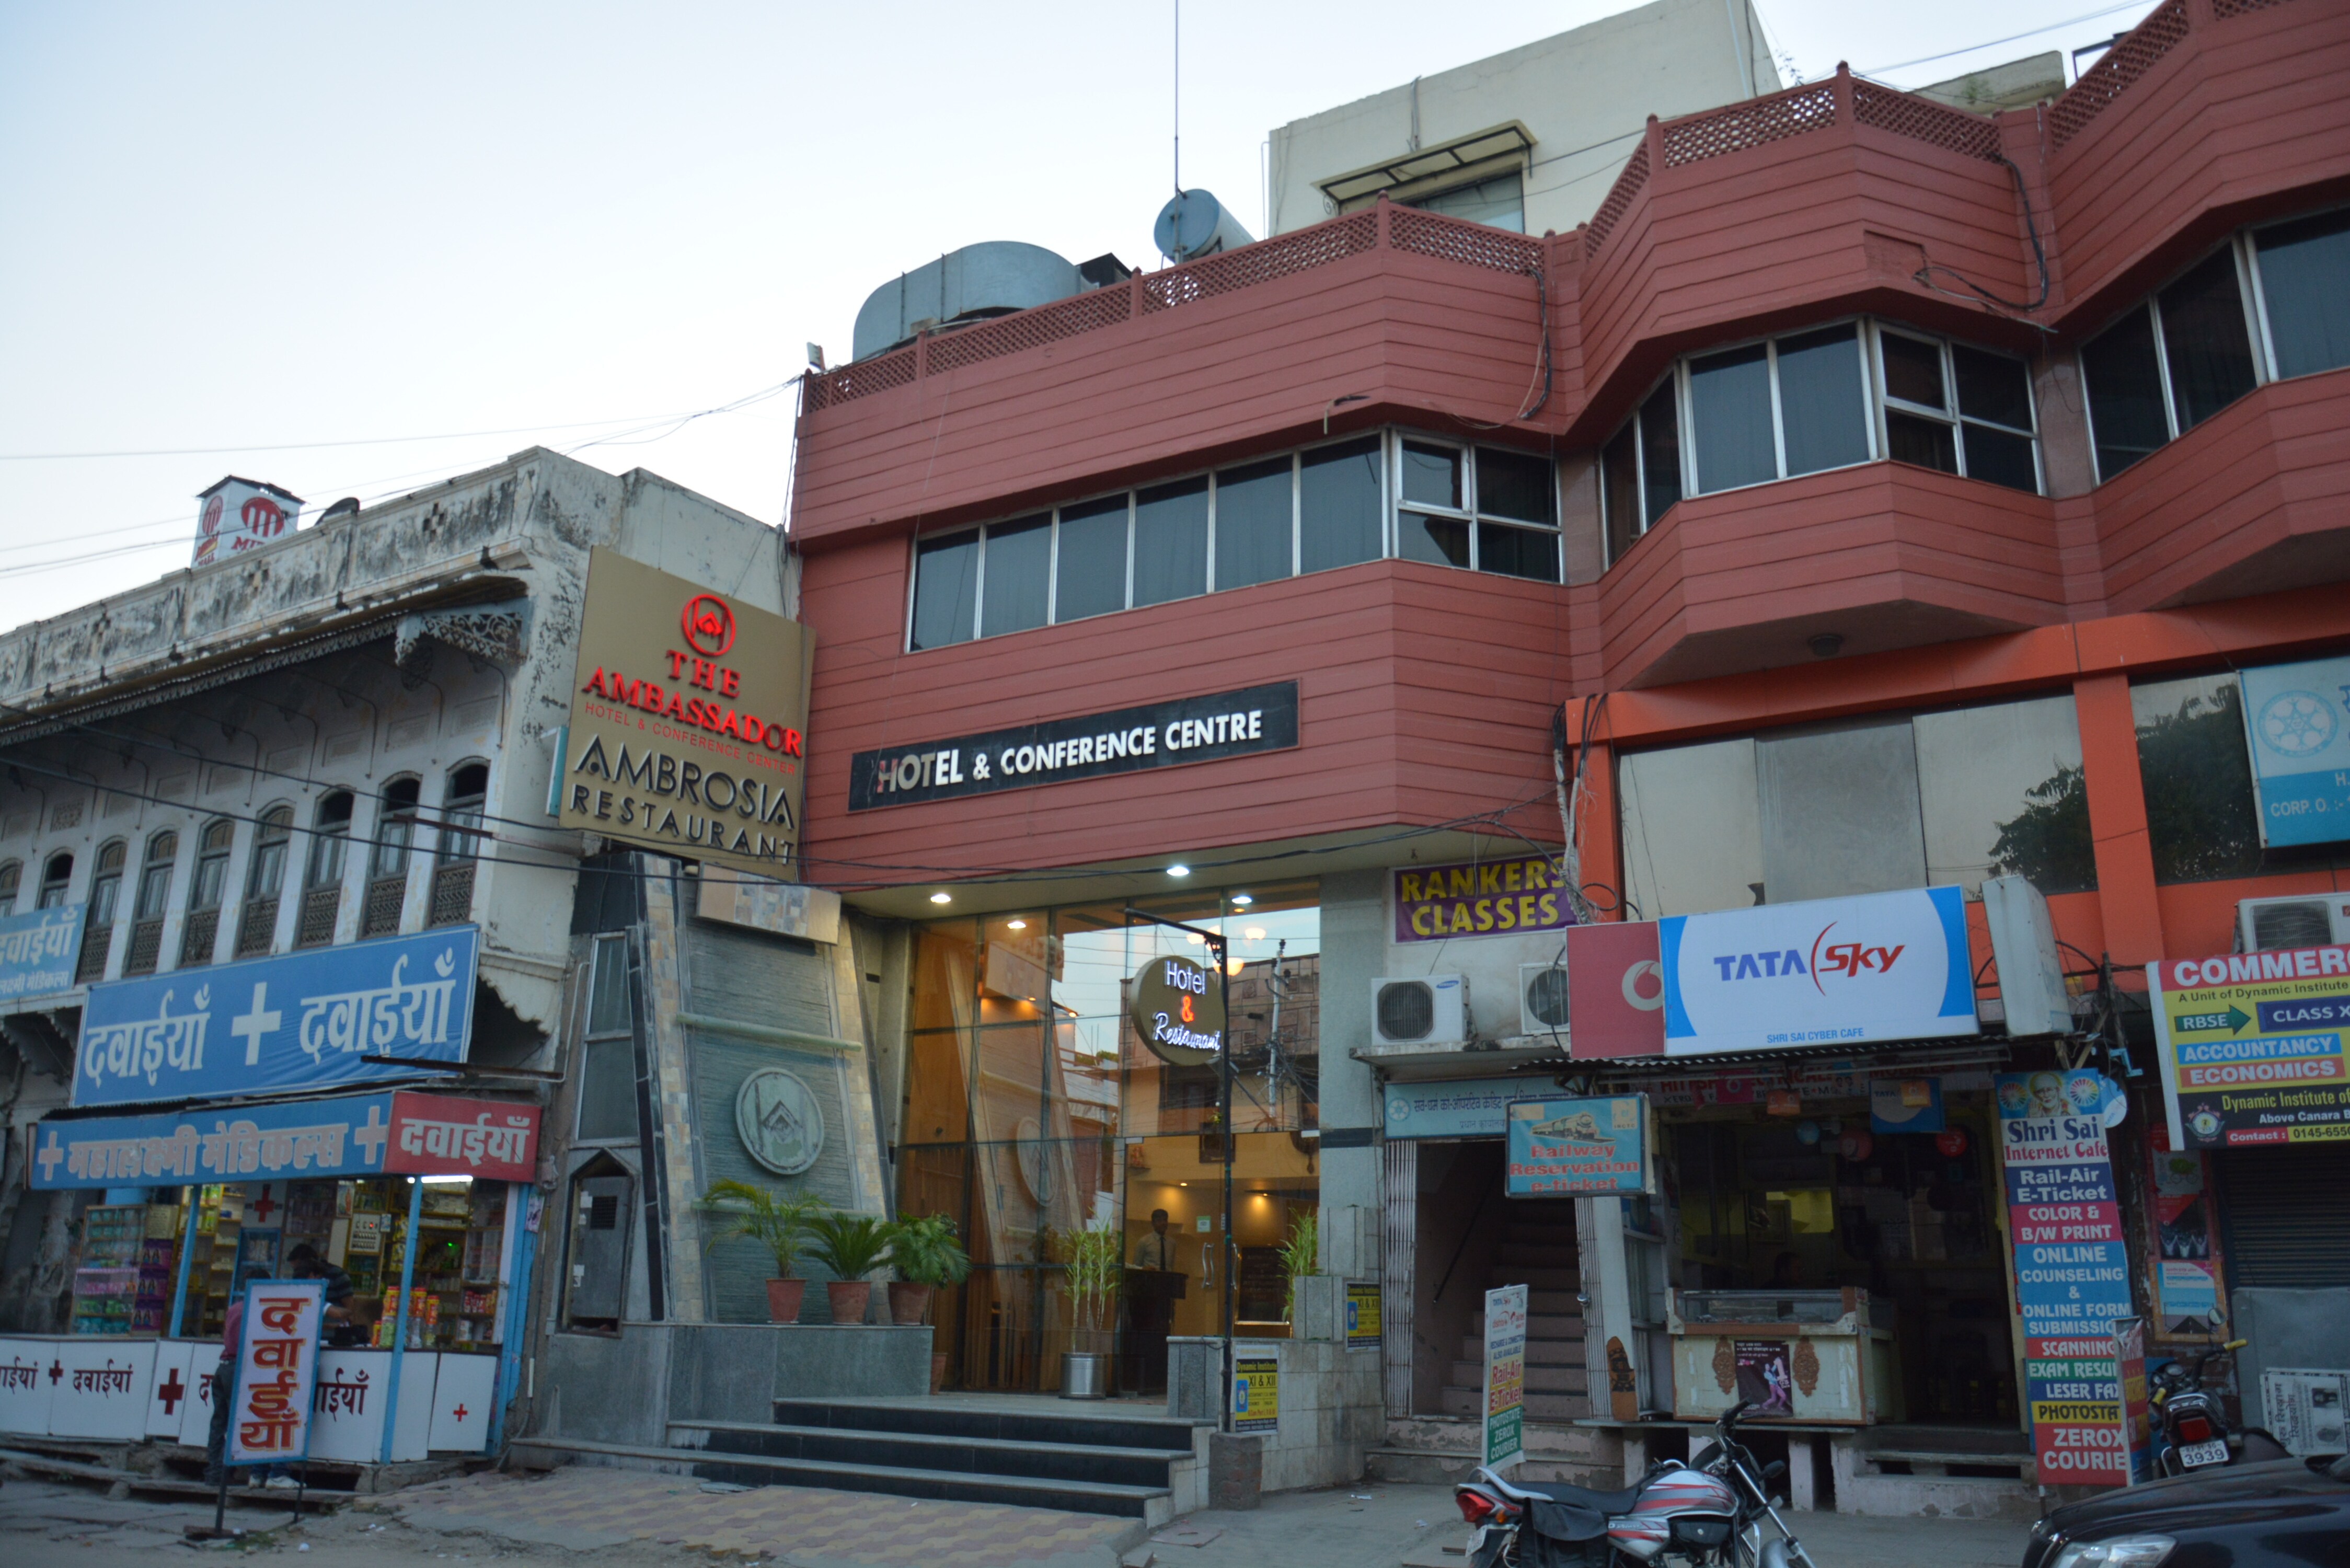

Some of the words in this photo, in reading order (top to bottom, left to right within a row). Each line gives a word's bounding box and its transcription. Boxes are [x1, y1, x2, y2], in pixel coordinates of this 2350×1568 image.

[666, 650, 741, 699] THE
[582, 666, 803, 758] AMBASSADOR
[585, 702, 630, 727] HOTEL
[638, 719, 646, 731] &
[652, 723, 741, 759] CONFERENCE
[747, 752, 797, 776] CENTER
[877, 750, 964, 794] HOTEL
[973, 753, 991, 781] &
[1000, 726, 1156, 776] CONFERENCE
[1165, 710, 1262, 751] CENTRE
[574, 734, 795, 830] AMBROSIA
[2271, 800, 2312, 816] CORP.
[570, 783, 794, 865] RESTAURANT
[1401, 857, 1564, 903] RANKERS
[1412, 893, 1559, 936] CLASSES
[1714, 949, 1807, 982] TATA
[1165, 960, 1206, 995] Hotel
[2179, 994, 2188, 1002] A
[2191, 990, 2217, 1001] Unit
[2220, 989, 2232, 999] of
[2236, 985, 2291, 999] Dynamic
[2295, 980, 2348, 993] Institute
[85, 983, 211, 1089] दवाईयाँ
[299, 947, 456, 1065] दवाईयाँ
[1181, 995, 1194, 1022] &
[2183, 1014, 2228, 1029] RBSE
[2273, 1006, 2334, 1022] CLASS
[1767, 1033, 1788, 1044] SHRI
[1790, 1032, 1805, 1042] SAI
[1808, 1030, 1837, 1041] CYBER
[1840, 1028, 1864, 1038] CAFE
[2184, 1036, 2333, 1062] ACCOUNTANCY
[2190, 1060, 2336, 1085] ECONOMICS
[2221, 1093, 2276, 1113] Dynamic
[2280, 1090, 2335, 1108] Institute
[2259, 1113, 2295, 1124] Above
[2298, 1110, 2340, 1122] Canara
[2007, 1119, 2057, 1144] Shri
[2064, 1116, 2100, 1140] Sai
[2229, 1130, 2278, 1142] Contact
[202, 1120, 349, 1174] मेडिकल्स
[1530, 1144, 1616, 1159] Railway
[2004, 1144, 2070, 1161] Internet
[2075, 1140, 2109, 1159] Cafe
[1510, 1160, 1639, 1177] Reservation
[2020, 1168, 2100, 1185] Rail-Air
[1531, 1177, 1618, 1192] e-ticket
[2017, 1185, 2107, 1203] E-Ticket
[2028, 1207, 2083, 1221] COLOR
[2087, 1206, 2100, 1219] &
[2021, 1227, 2056, 1243] B/W
[2062, 1224, 2112, 1240] PRINT
[2033, 1246, 2107, 1264] ONLINE
[2021, 1267, 2124, 1283] COUNSELING
[2068, 1286, 2080, 1299] &
[2022, 1304, 2081, 1318] ONLINE
[2086, 1303, 2132, 1317] FORM
[1249, 1375, 1255, 1387] XI
[1259, 1375, 1263, 1387] &
[1266, 1375, 1276, 1387] XII
[1493, 1360, 1522, 1385] Rail-Air
[2029, 1363, 2069, 1378] EXAM
[1490, 1382, 1522, 1412] E-Ticket
[2046, 1383, 2090, 1400] LESER
[1495, 1424, 1515, 1443] ZEROX
[2054, 1428, 2124, 1447] ZEROX
[1491, 1437, 1518, 1460] COURIER
[2184, 1448, 2225, 1465] 3939
